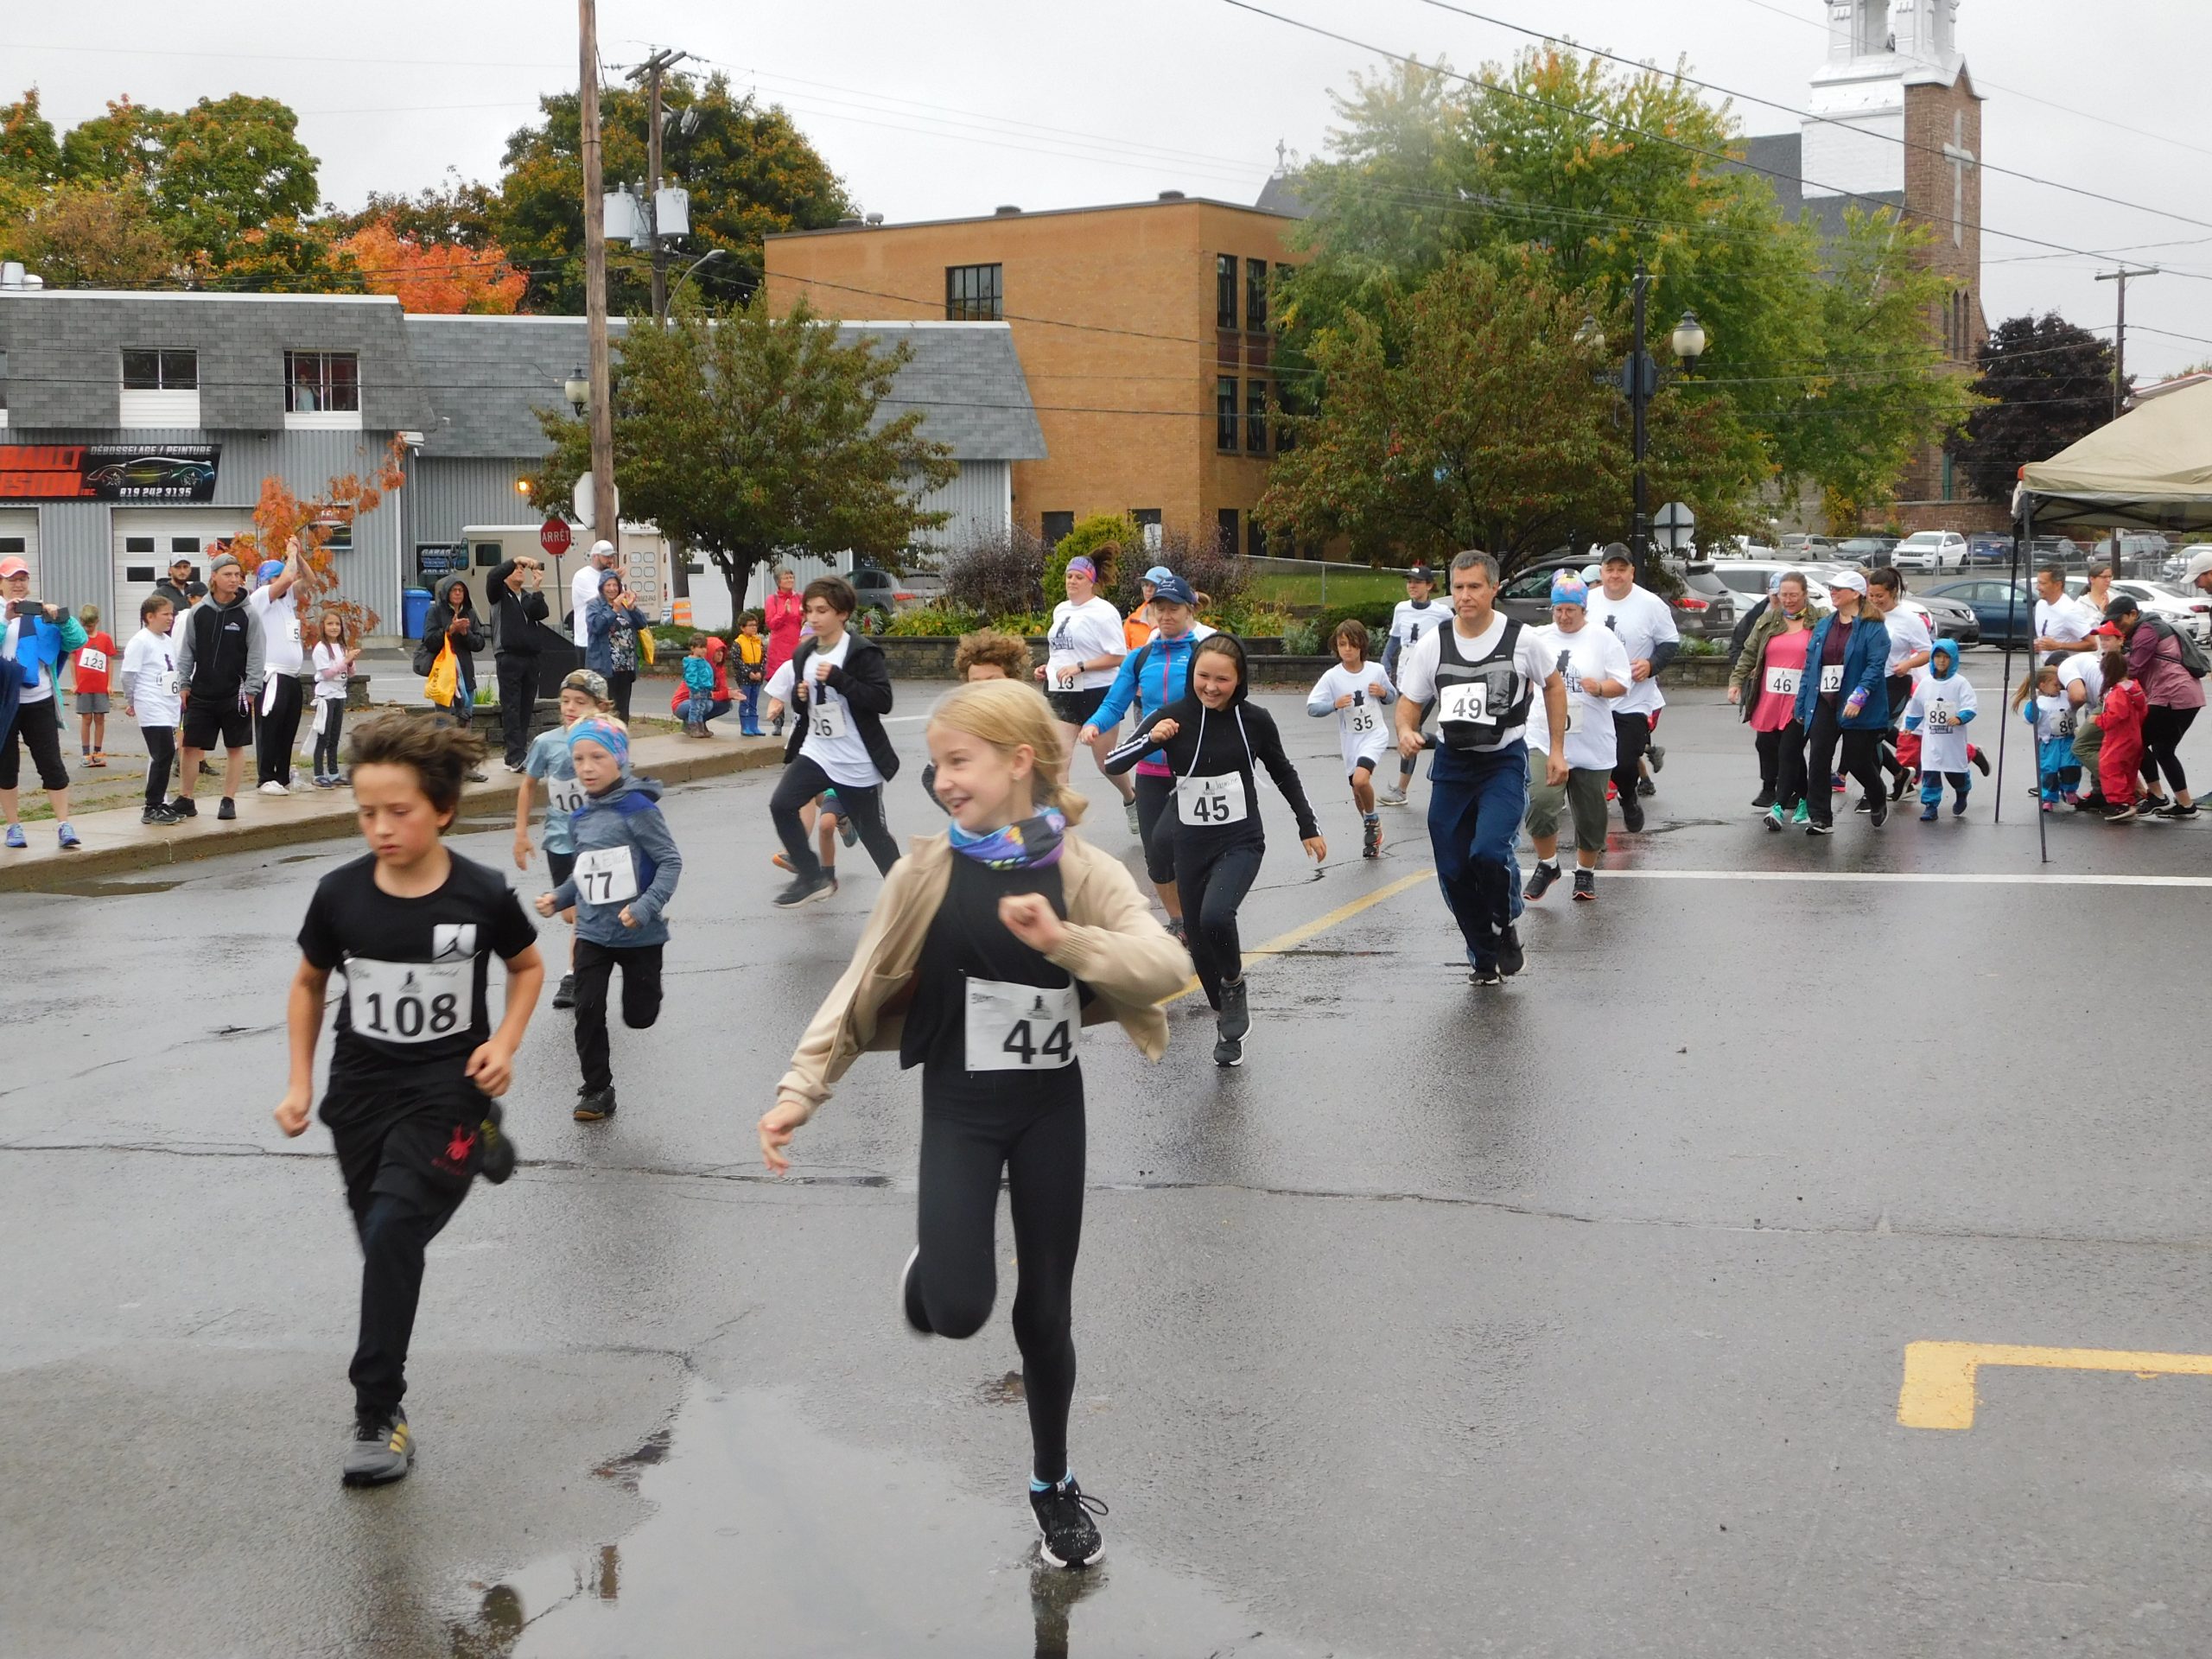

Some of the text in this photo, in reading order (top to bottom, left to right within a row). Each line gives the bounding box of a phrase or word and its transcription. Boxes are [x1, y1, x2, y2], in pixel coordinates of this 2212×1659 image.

[90, 444, 156, 454] DÉBOSSELAGE
[166, 445, 212, 454] PEINTURE
[120, 487, 192, 498] 819 242 3135
[542, 528, 569, 543] ARRÊT
[84, 656, 104, 670] 123
[1773, 677, 1792, 692] 46
[1824, 676, 1840, 690] 12
[1452, 697, 1482, 719] 49
[1353, 715, 1374, 732] 35
[1929, 710, 1947, 724] 88
[812, 718, 833, 736] 26
[2059, 718, 2074, 733] 86
[1193, 795, 1230, 822] 45
[583, 871, 613, 901] 77
[366, 993, 457, 1037] 108
[1003, 1019, 1072, 1065] 44
